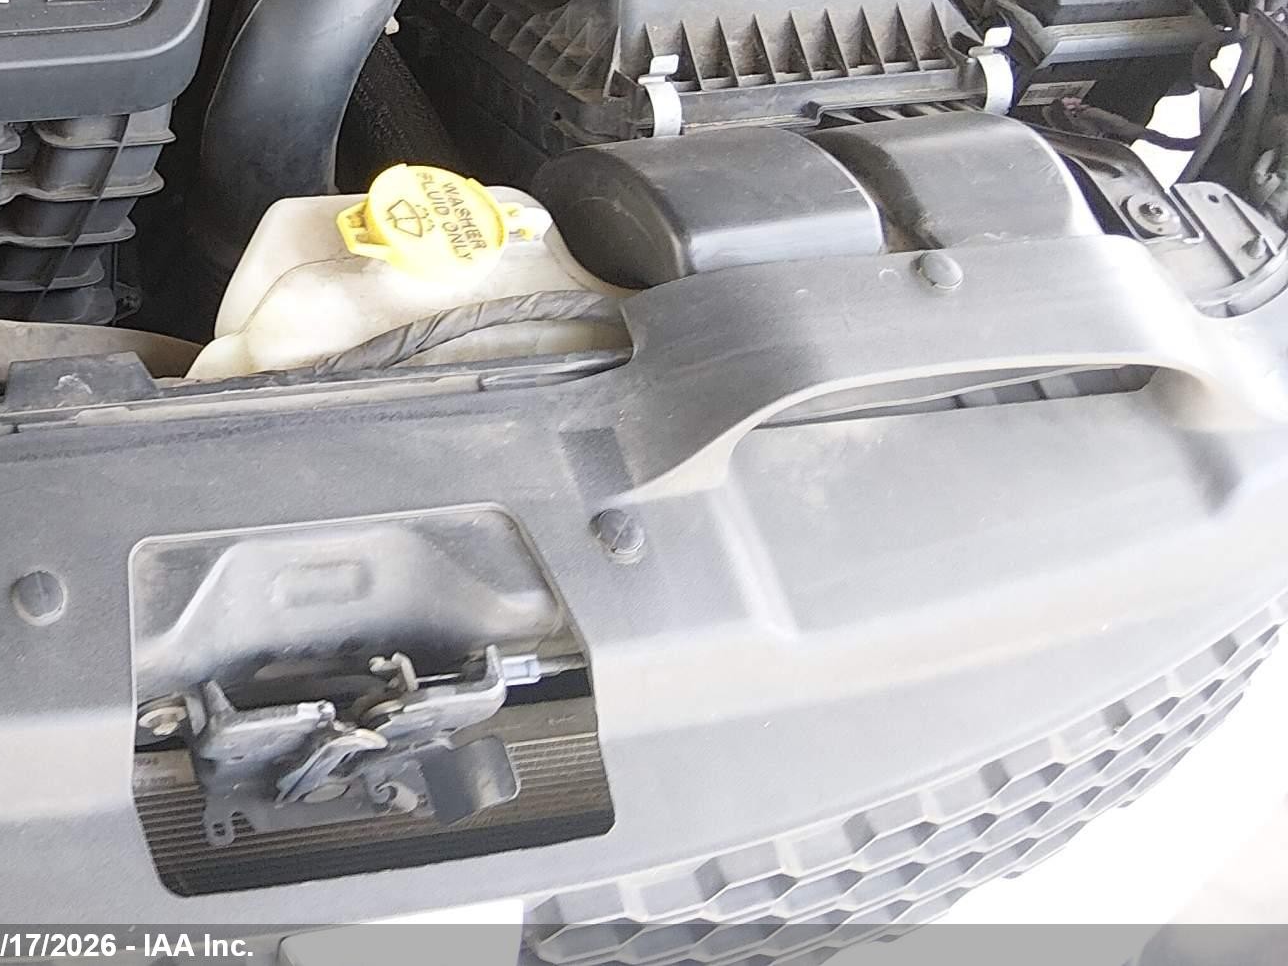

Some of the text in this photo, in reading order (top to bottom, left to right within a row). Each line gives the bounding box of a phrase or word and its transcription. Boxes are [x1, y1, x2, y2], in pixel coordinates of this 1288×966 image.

[416, 171, 473, 261] FLUID ONLY
[442, 182, 488, 251] WASHER
